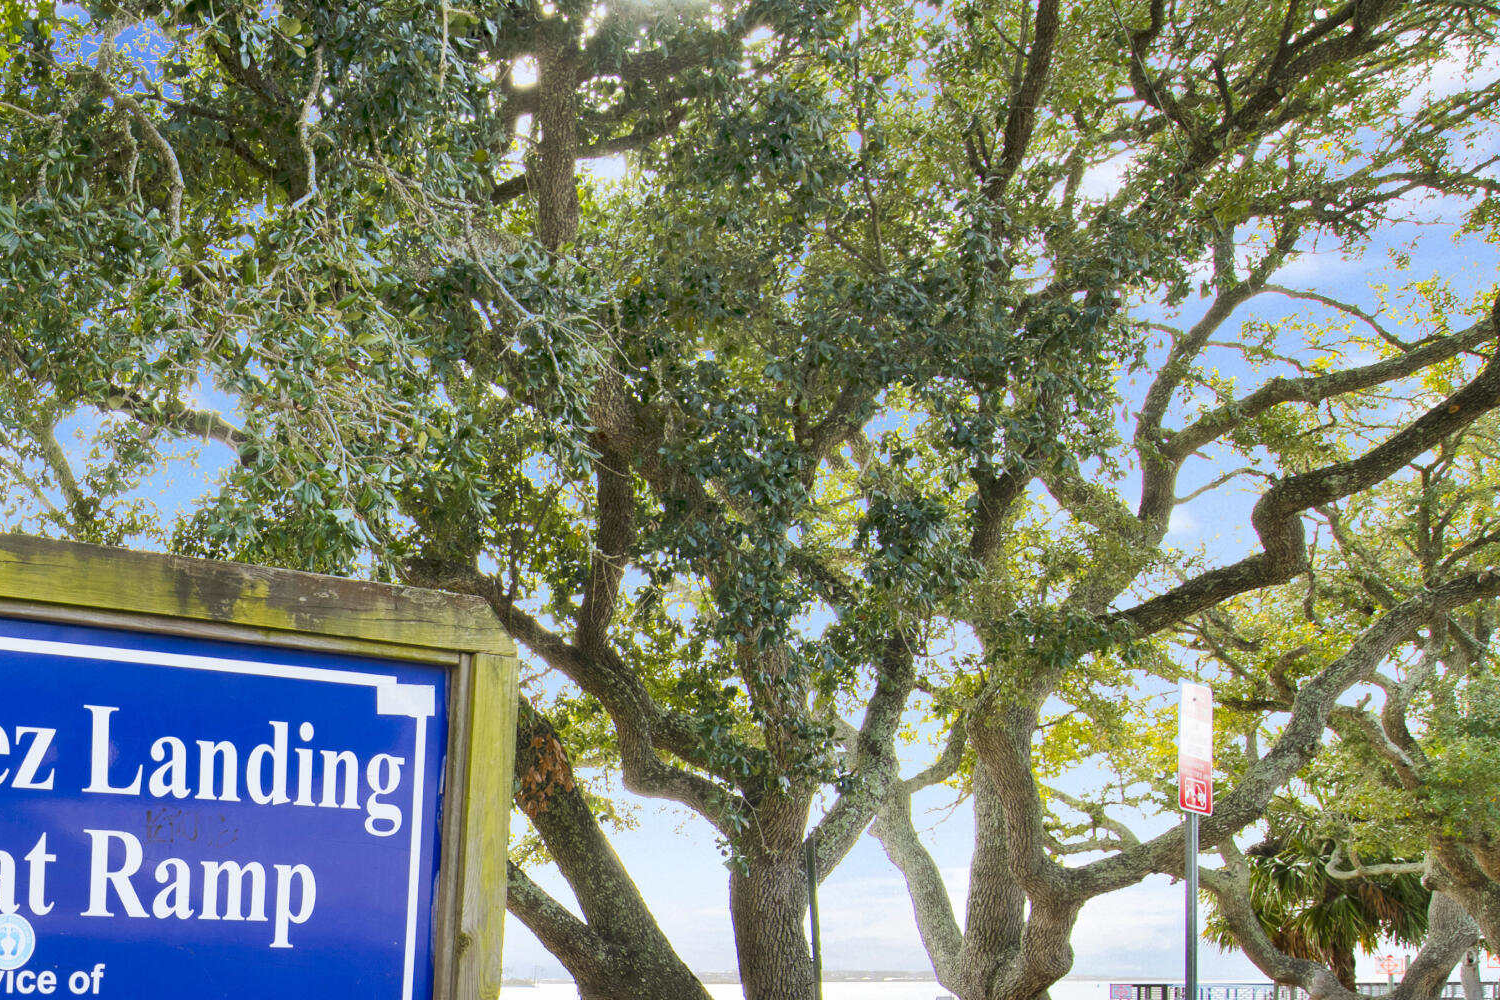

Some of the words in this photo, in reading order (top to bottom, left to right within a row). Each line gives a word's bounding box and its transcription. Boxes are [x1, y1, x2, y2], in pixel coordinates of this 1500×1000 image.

[82, 705, 406, 836] Landing
[81, 829, 317, 948] Ramp
[69, 964, 106, 995] of
